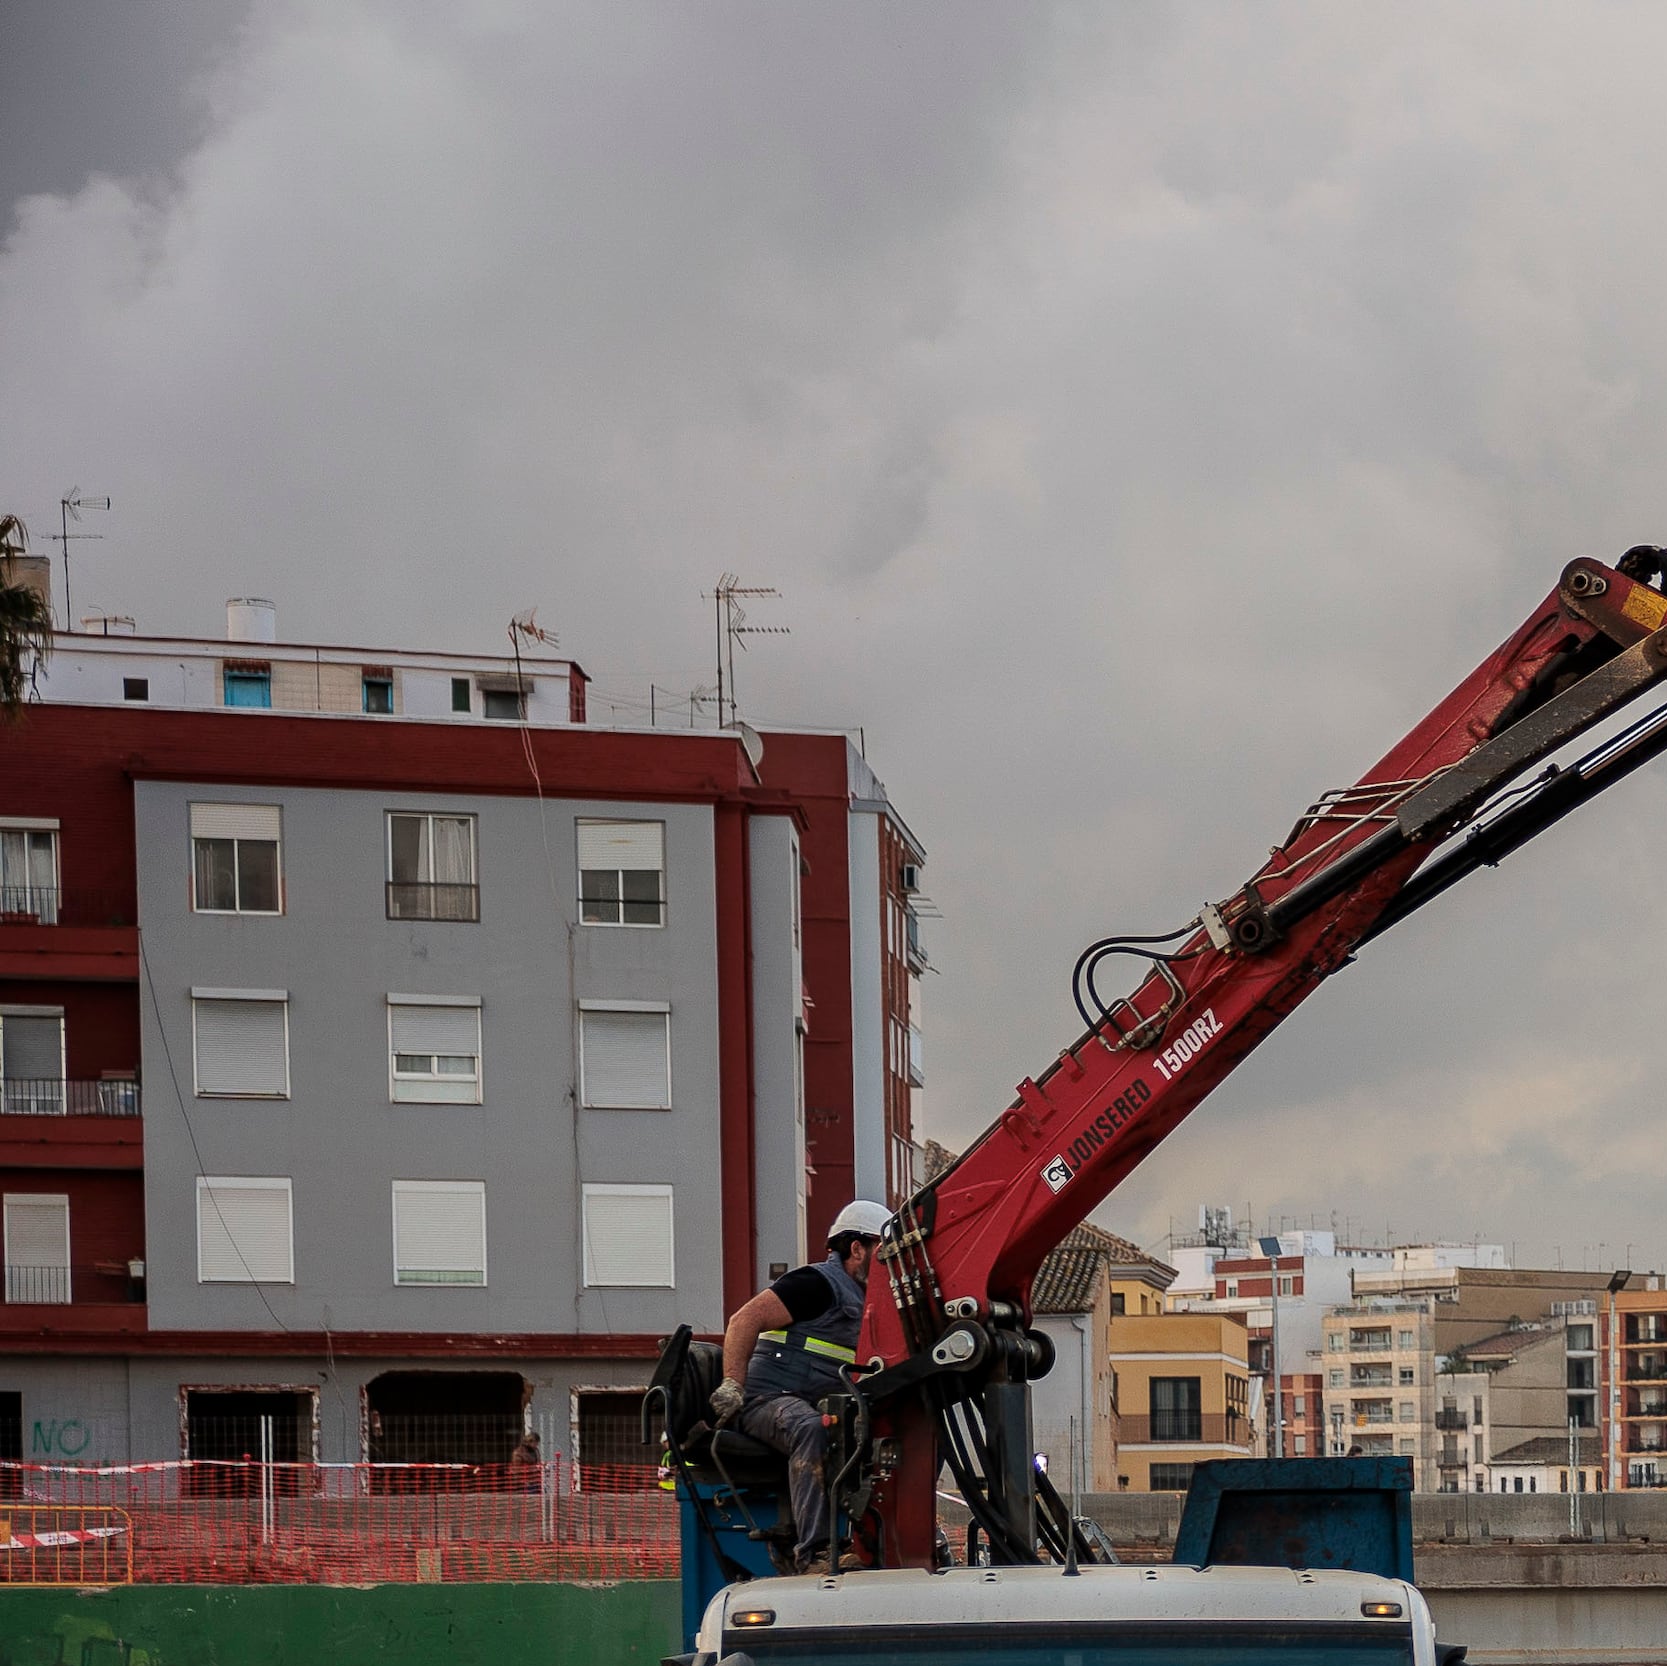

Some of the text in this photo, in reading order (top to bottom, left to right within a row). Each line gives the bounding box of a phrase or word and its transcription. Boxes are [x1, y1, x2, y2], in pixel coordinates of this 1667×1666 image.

[1066, 1007, 1225, 1172] JONSERED 1500RZ
[31, 1420, 92, 1456] NO
